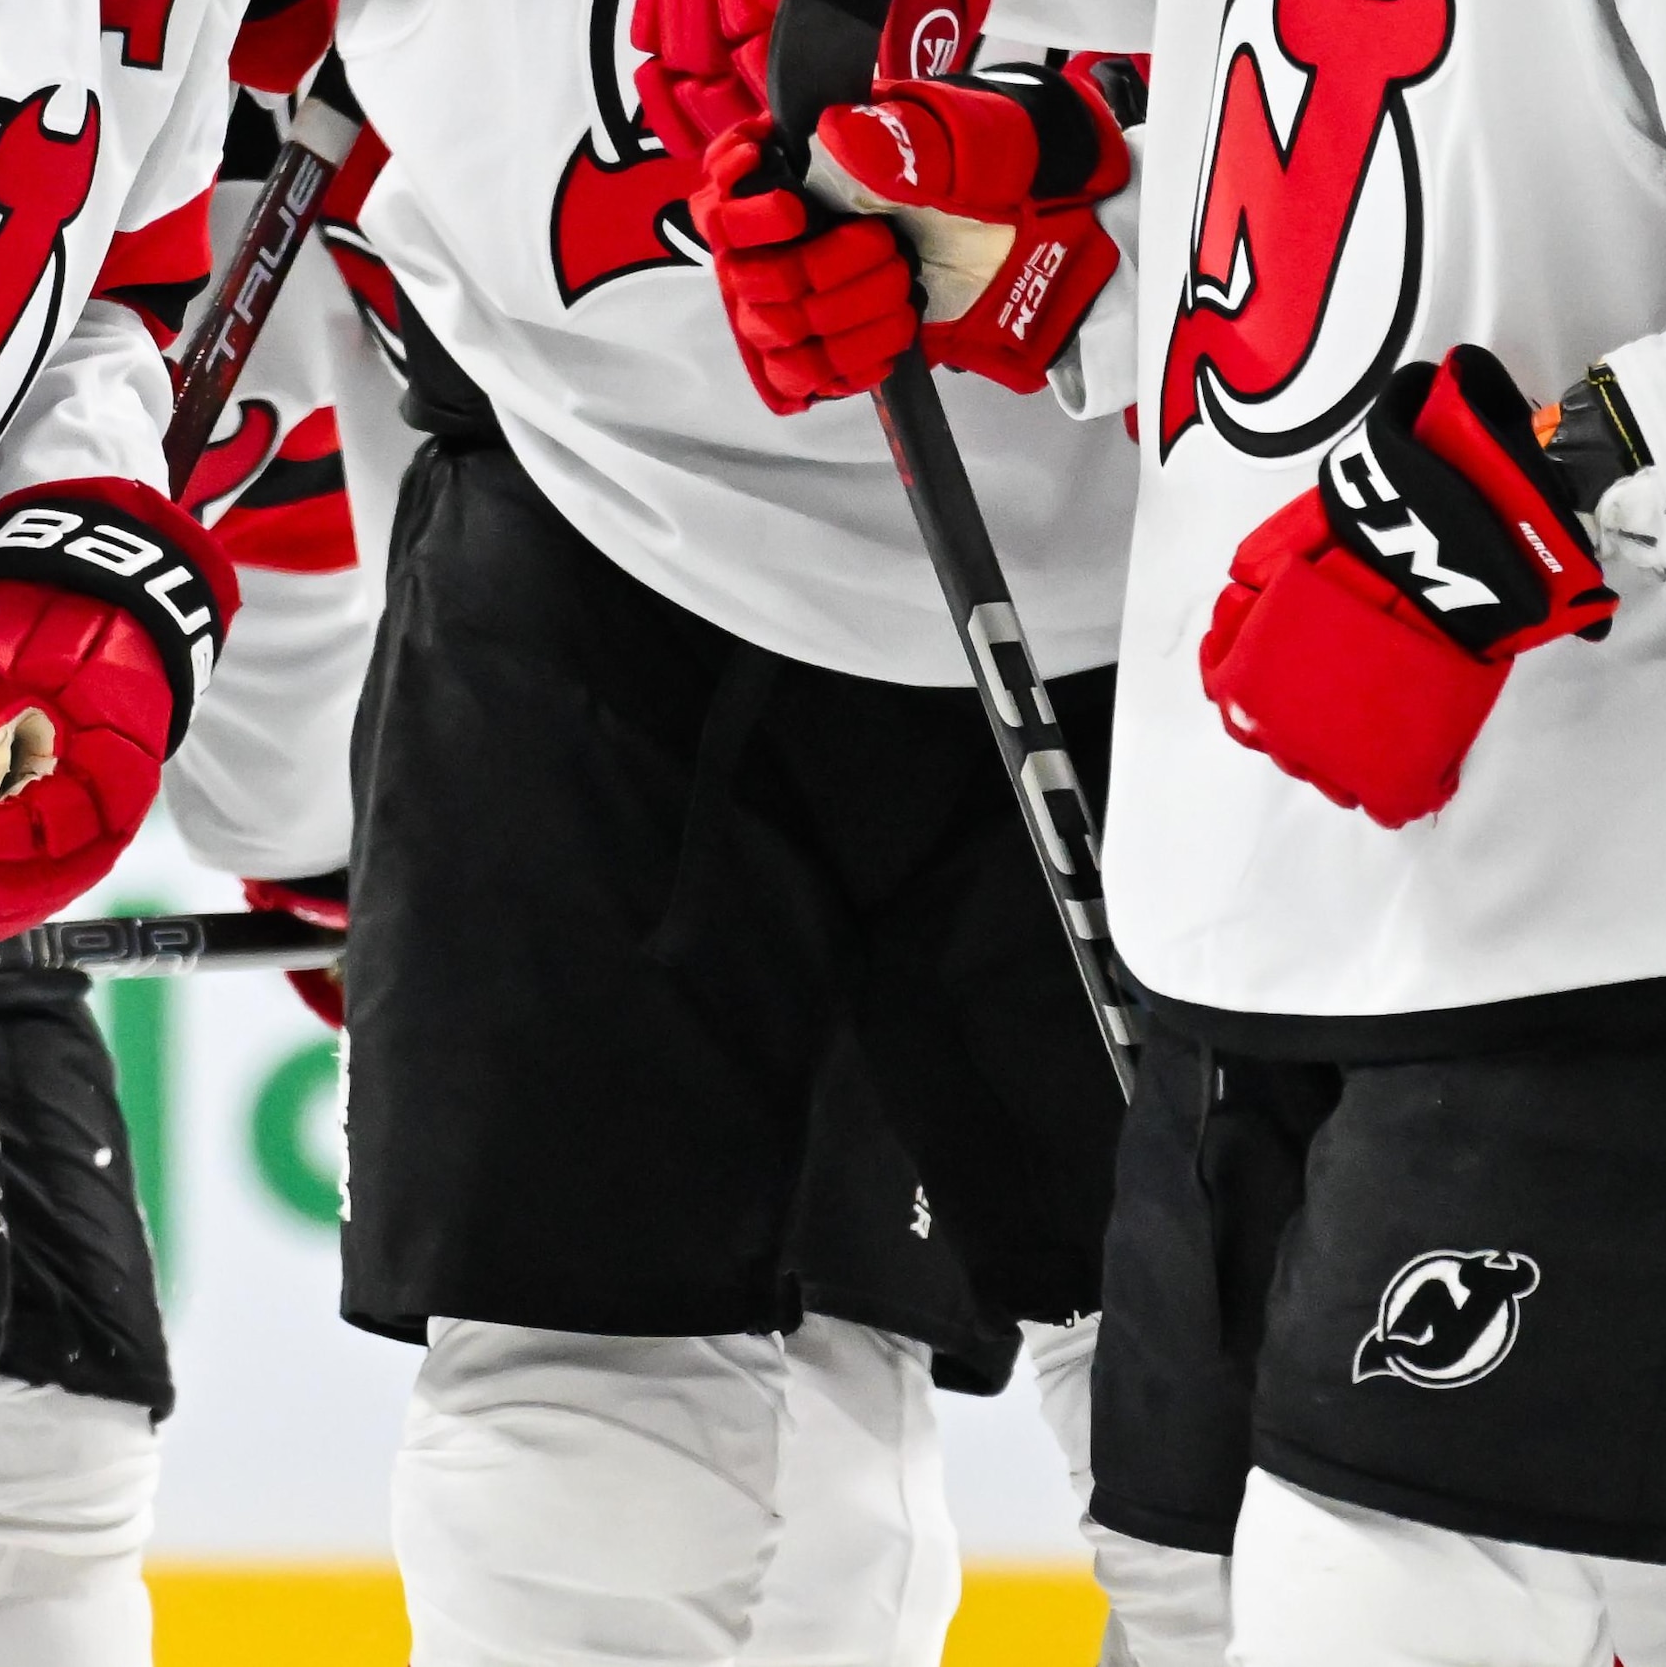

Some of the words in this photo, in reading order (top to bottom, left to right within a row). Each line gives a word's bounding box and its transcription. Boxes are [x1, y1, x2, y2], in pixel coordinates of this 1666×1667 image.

[206, 154, 323, 372] TRUE
[1010, 241, 1068, 341] CCM
[1519, 521, 1564, 574] MERCER
